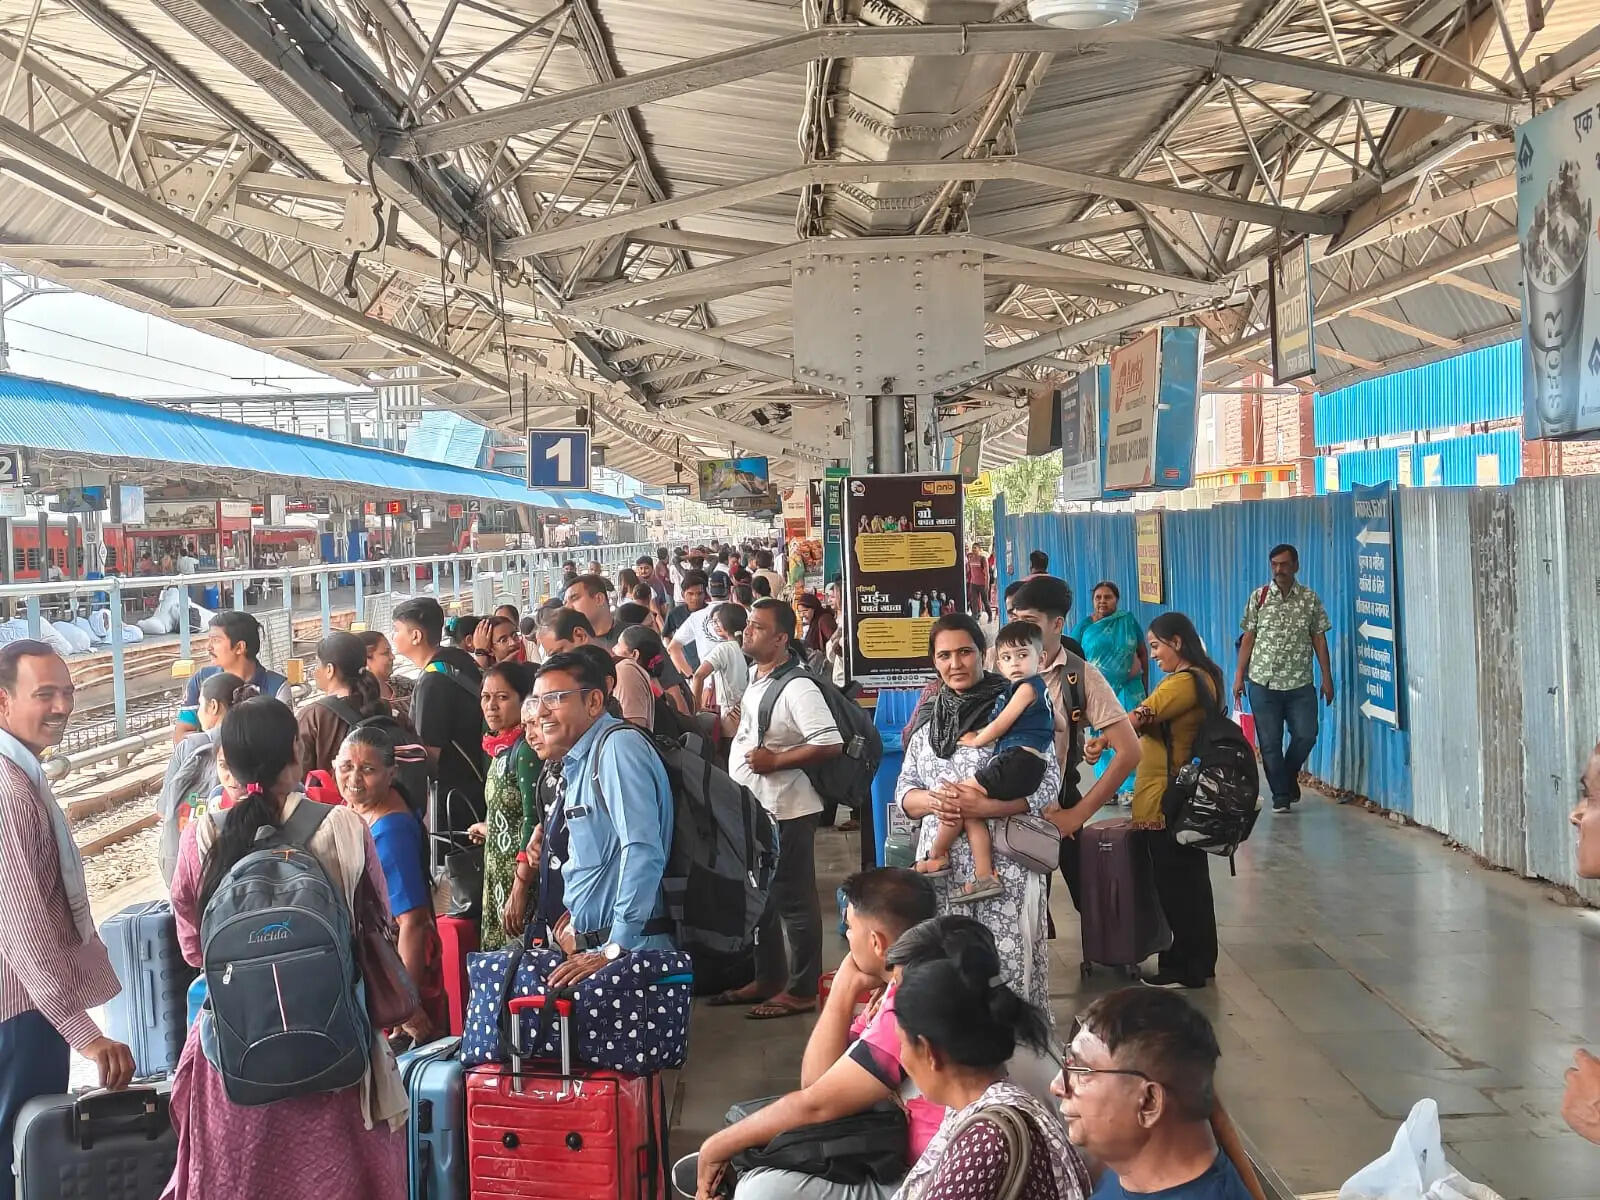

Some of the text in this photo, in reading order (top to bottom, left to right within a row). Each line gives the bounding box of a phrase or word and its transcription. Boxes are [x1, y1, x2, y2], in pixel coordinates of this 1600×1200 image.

[1573, 107, 1593, 143] एक
[0, 456, 13, 481] 2
[545, 437, 573, 482] 1
[469, 500, 479, 511] 2
[248, 928, 288, 944] Lucida
